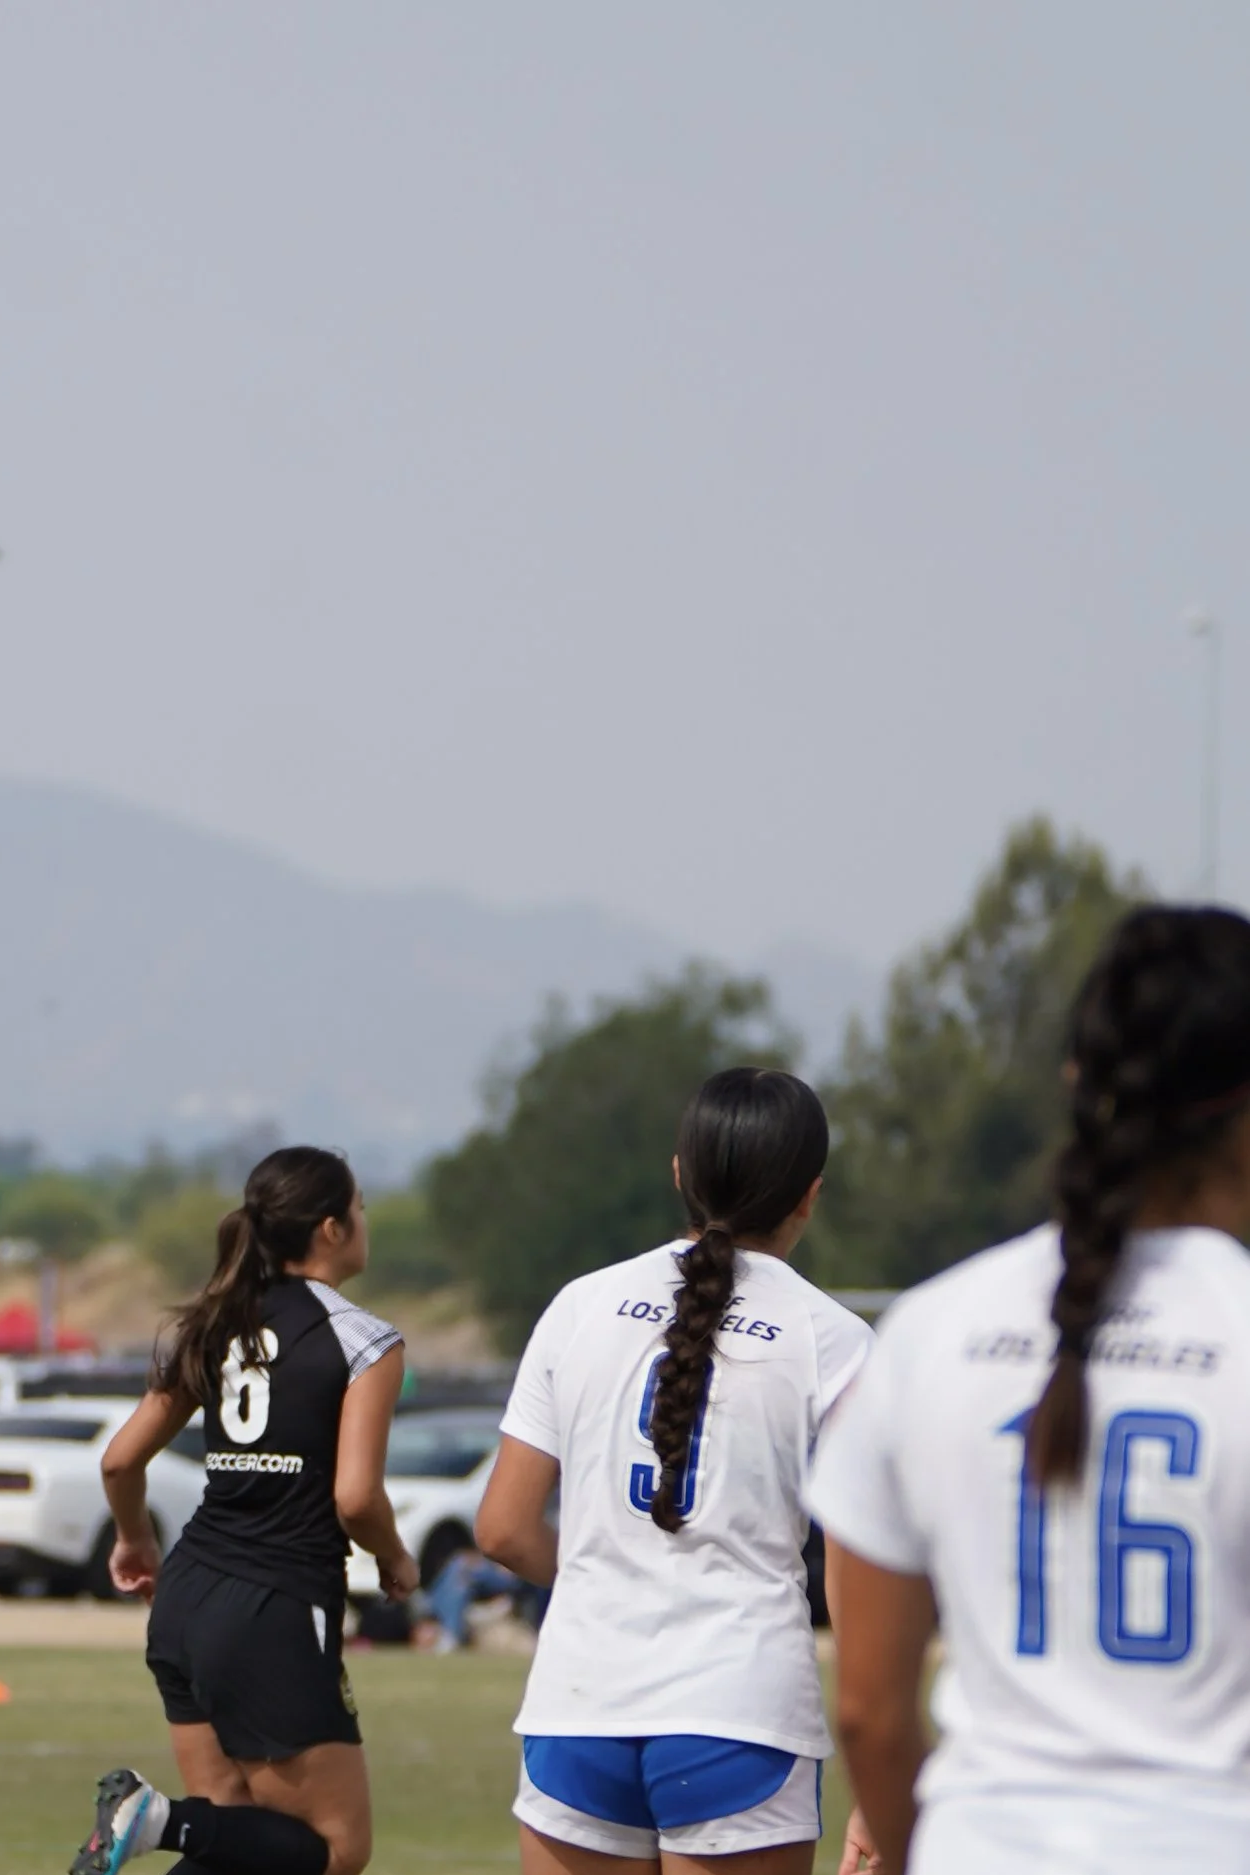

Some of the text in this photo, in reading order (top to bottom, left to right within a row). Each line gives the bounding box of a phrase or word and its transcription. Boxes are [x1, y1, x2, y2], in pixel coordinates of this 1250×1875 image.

[617, 1300, 669, 1323] LOS
[220, 1327, 280, 1445] 6
[629, 1350, 715, 1518] 9
[997, 1403, 1199, 1663] 16
